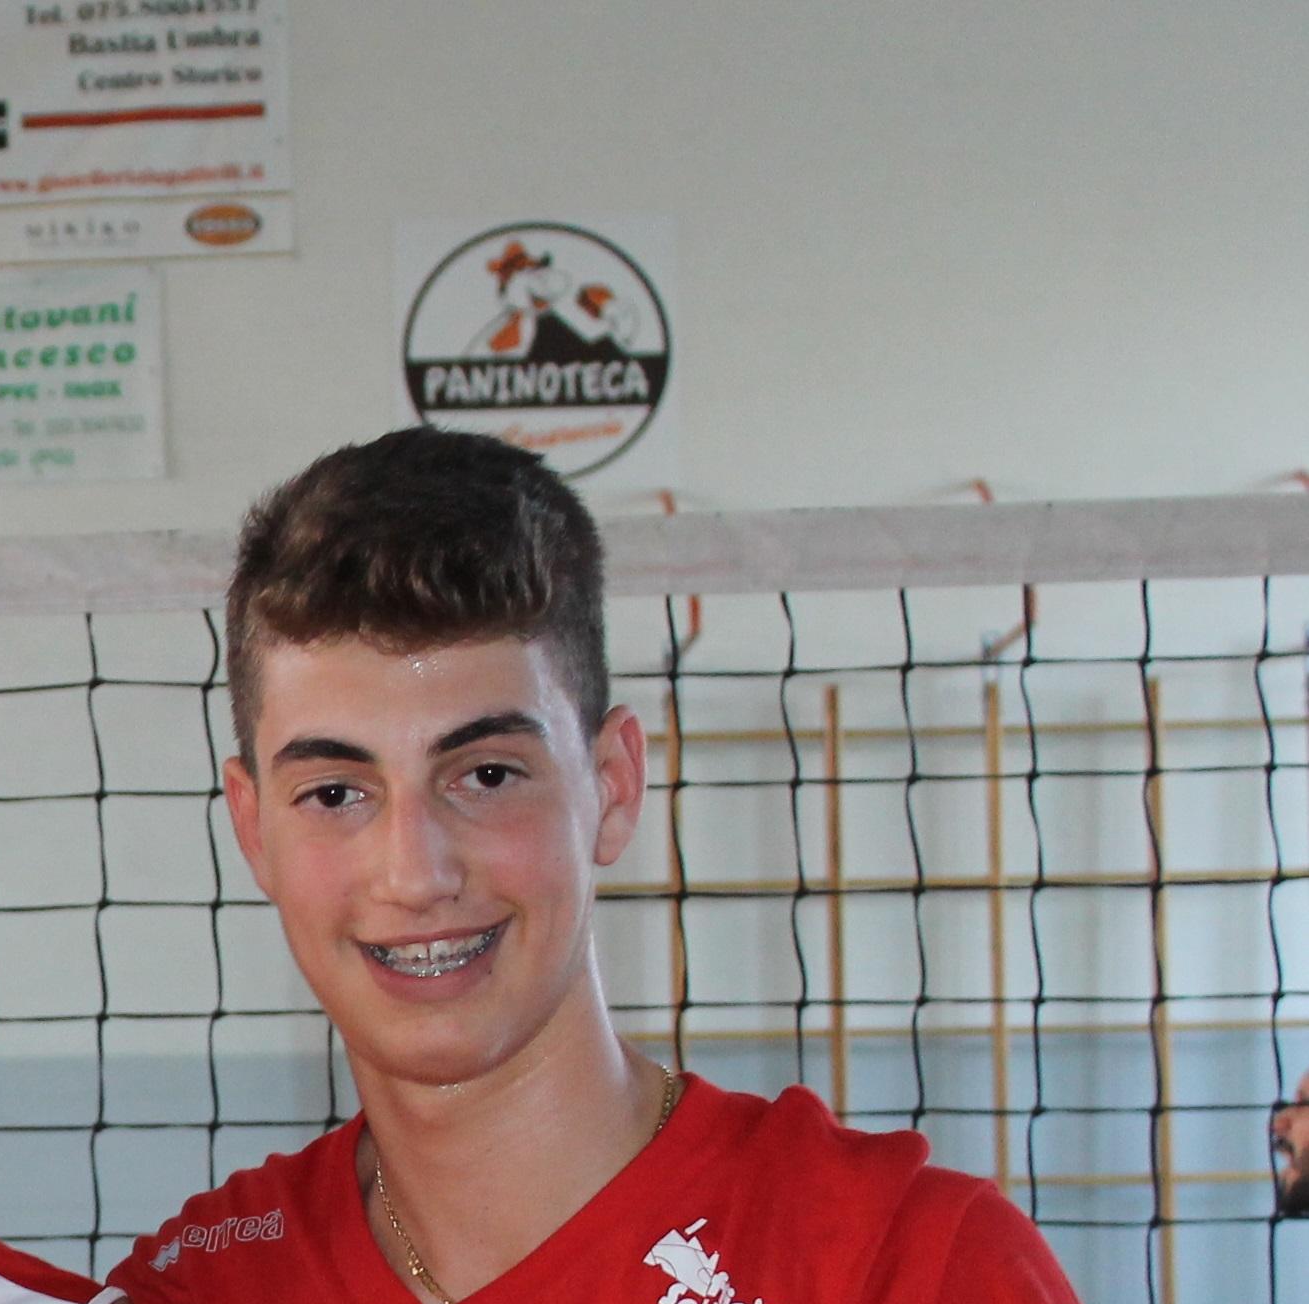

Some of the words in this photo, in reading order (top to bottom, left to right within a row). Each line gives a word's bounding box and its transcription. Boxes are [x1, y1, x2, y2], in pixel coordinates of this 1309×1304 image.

[68, 31, 158, 55] Bastia
[166, 25, 262, 50] Umbra
[77, 67, 164, 91] Centro
[172, 64, 264, 85] Storico
[423, 360, 651, 404] PANINOTECA
